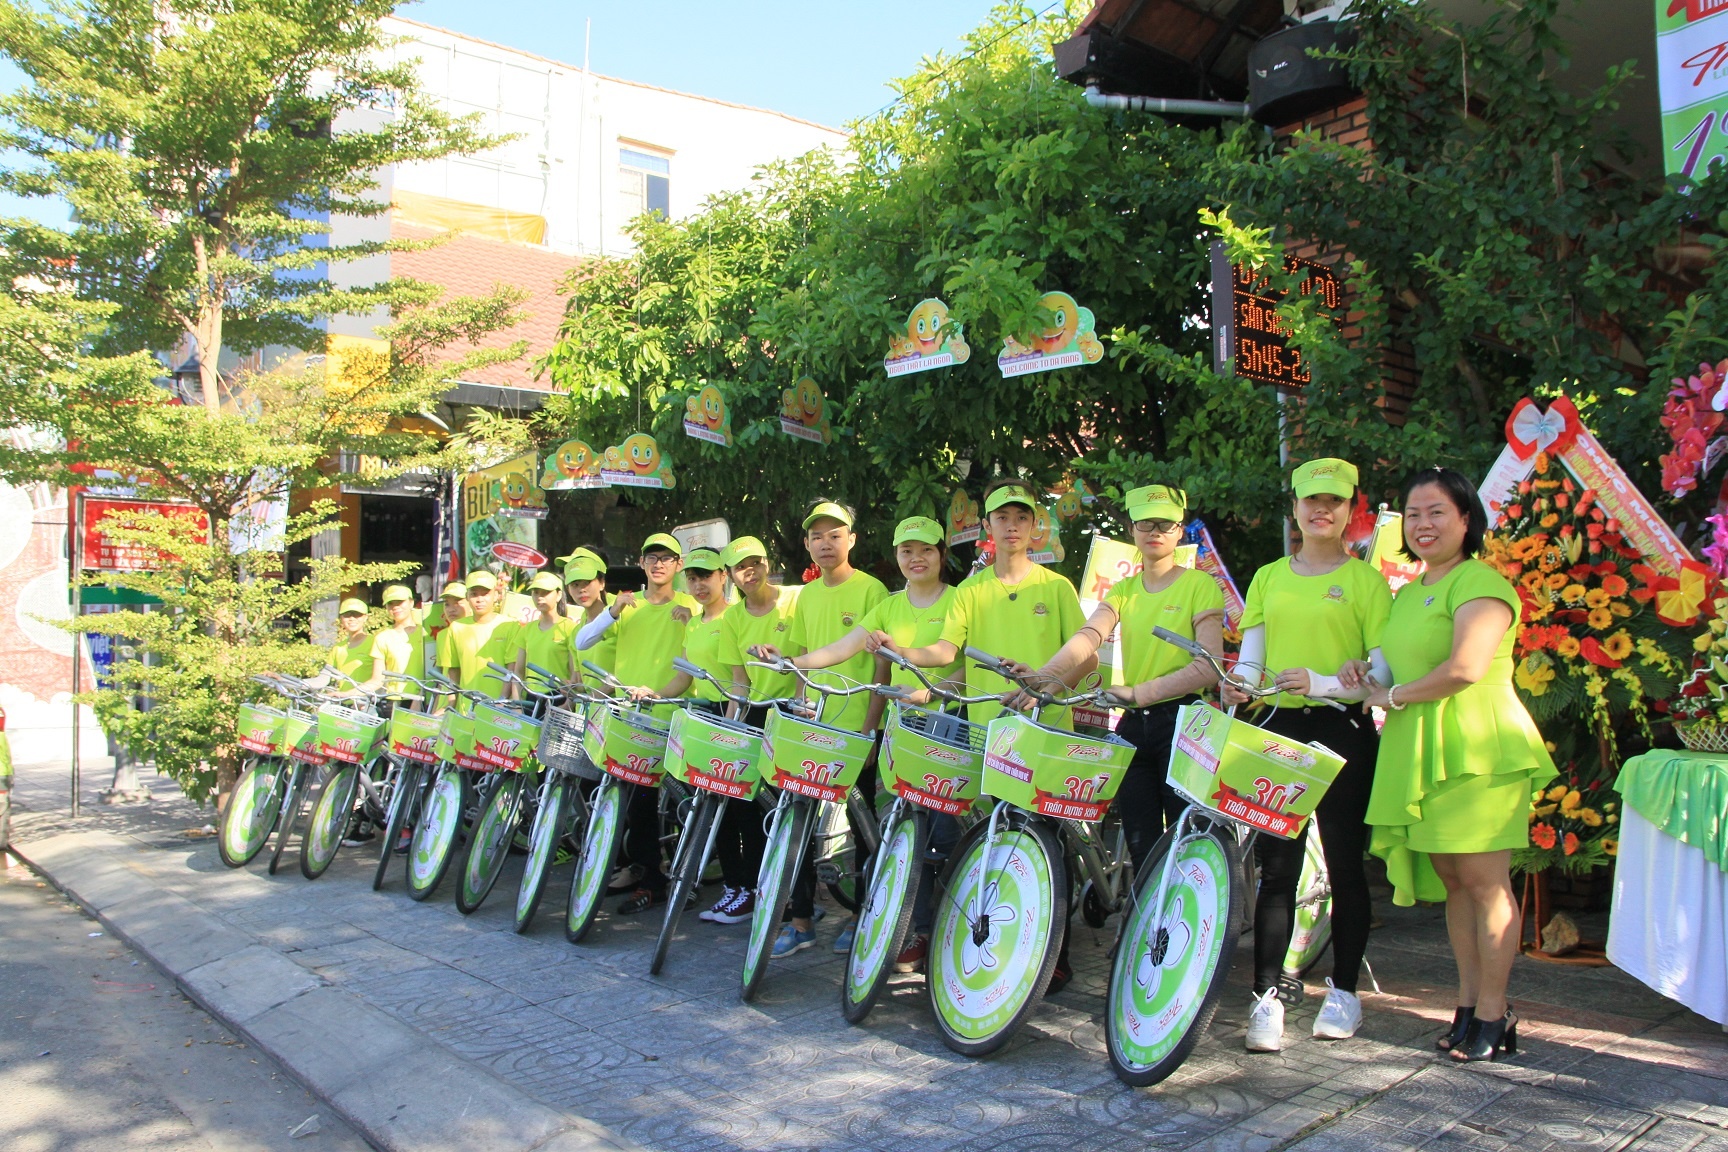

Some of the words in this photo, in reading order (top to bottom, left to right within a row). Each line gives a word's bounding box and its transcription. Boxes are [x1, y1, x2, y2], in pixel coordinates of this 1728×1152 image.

[1004, 361, 1038, 374] WELCOME
[1040, 359, 1049, 367] TO
[1061, 354, 1079, 364] NANG
